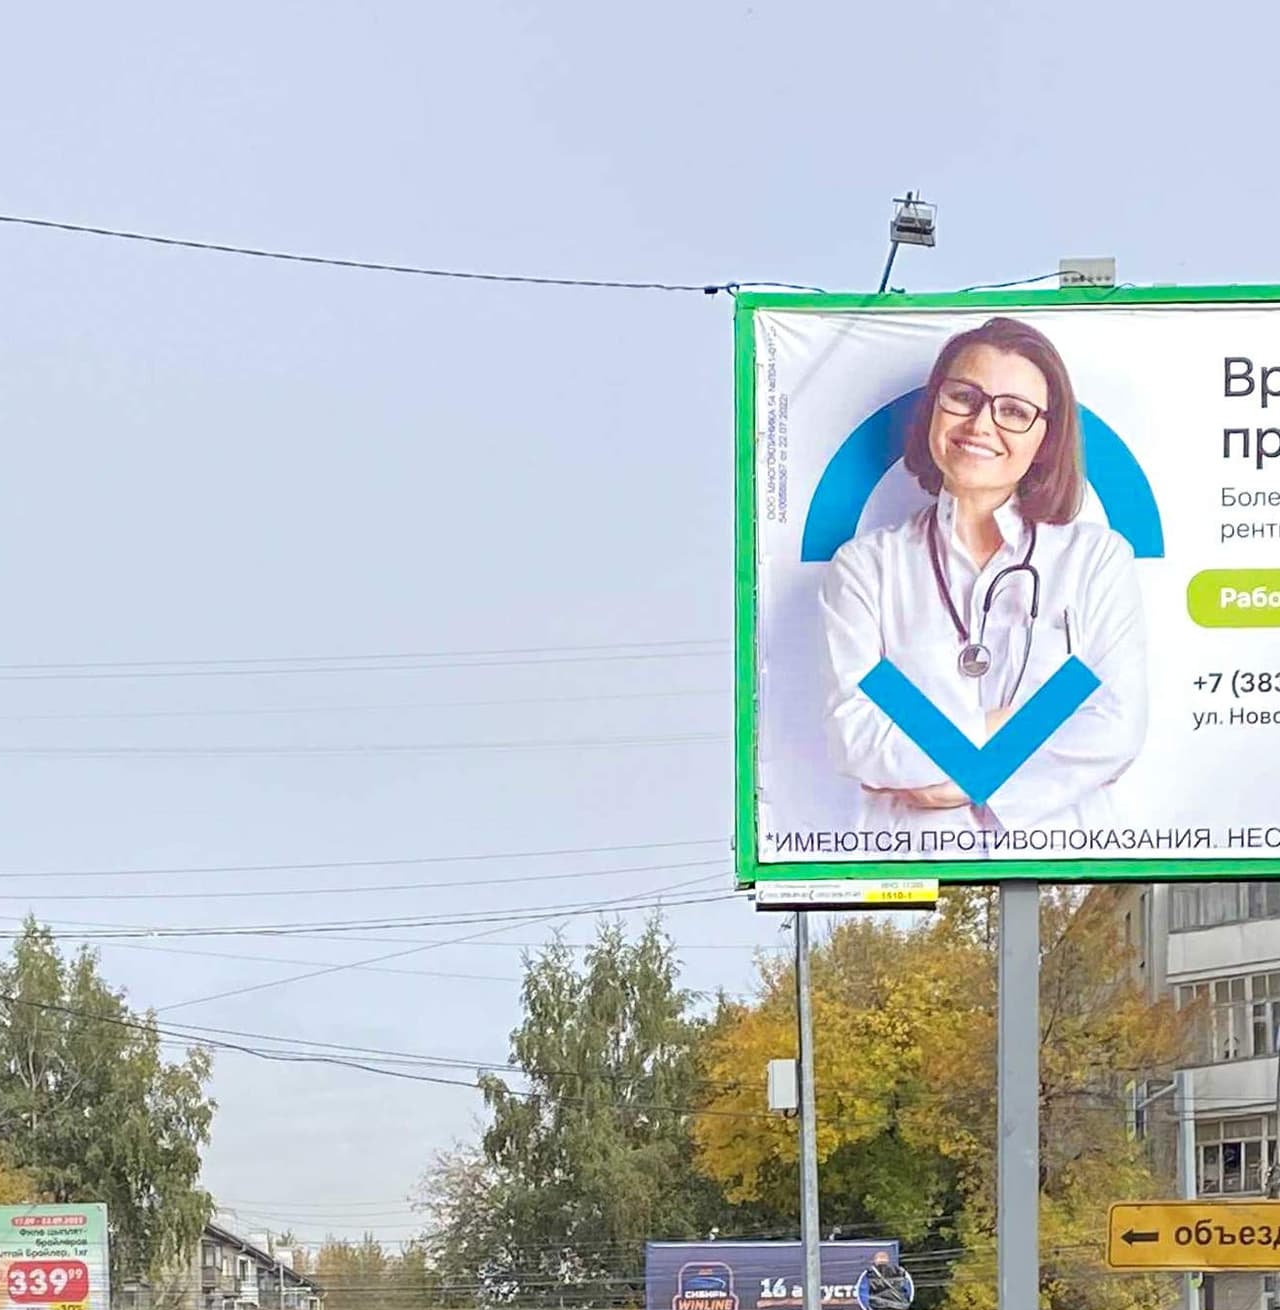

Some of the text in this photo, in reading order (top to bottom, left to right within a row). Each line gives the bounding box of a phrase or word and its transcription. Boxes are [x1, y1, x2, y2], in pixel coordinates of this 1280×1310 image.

[1192, 672, 1223, 694] +7
[1192, 711, 1224, 728] ул.
[920, 827, 1219, 852] ПРОТИВОПОКАЗАНИЯ.
[8, 1268, 68, 1296] 339
[760, 1278, 787, 1298] 16
